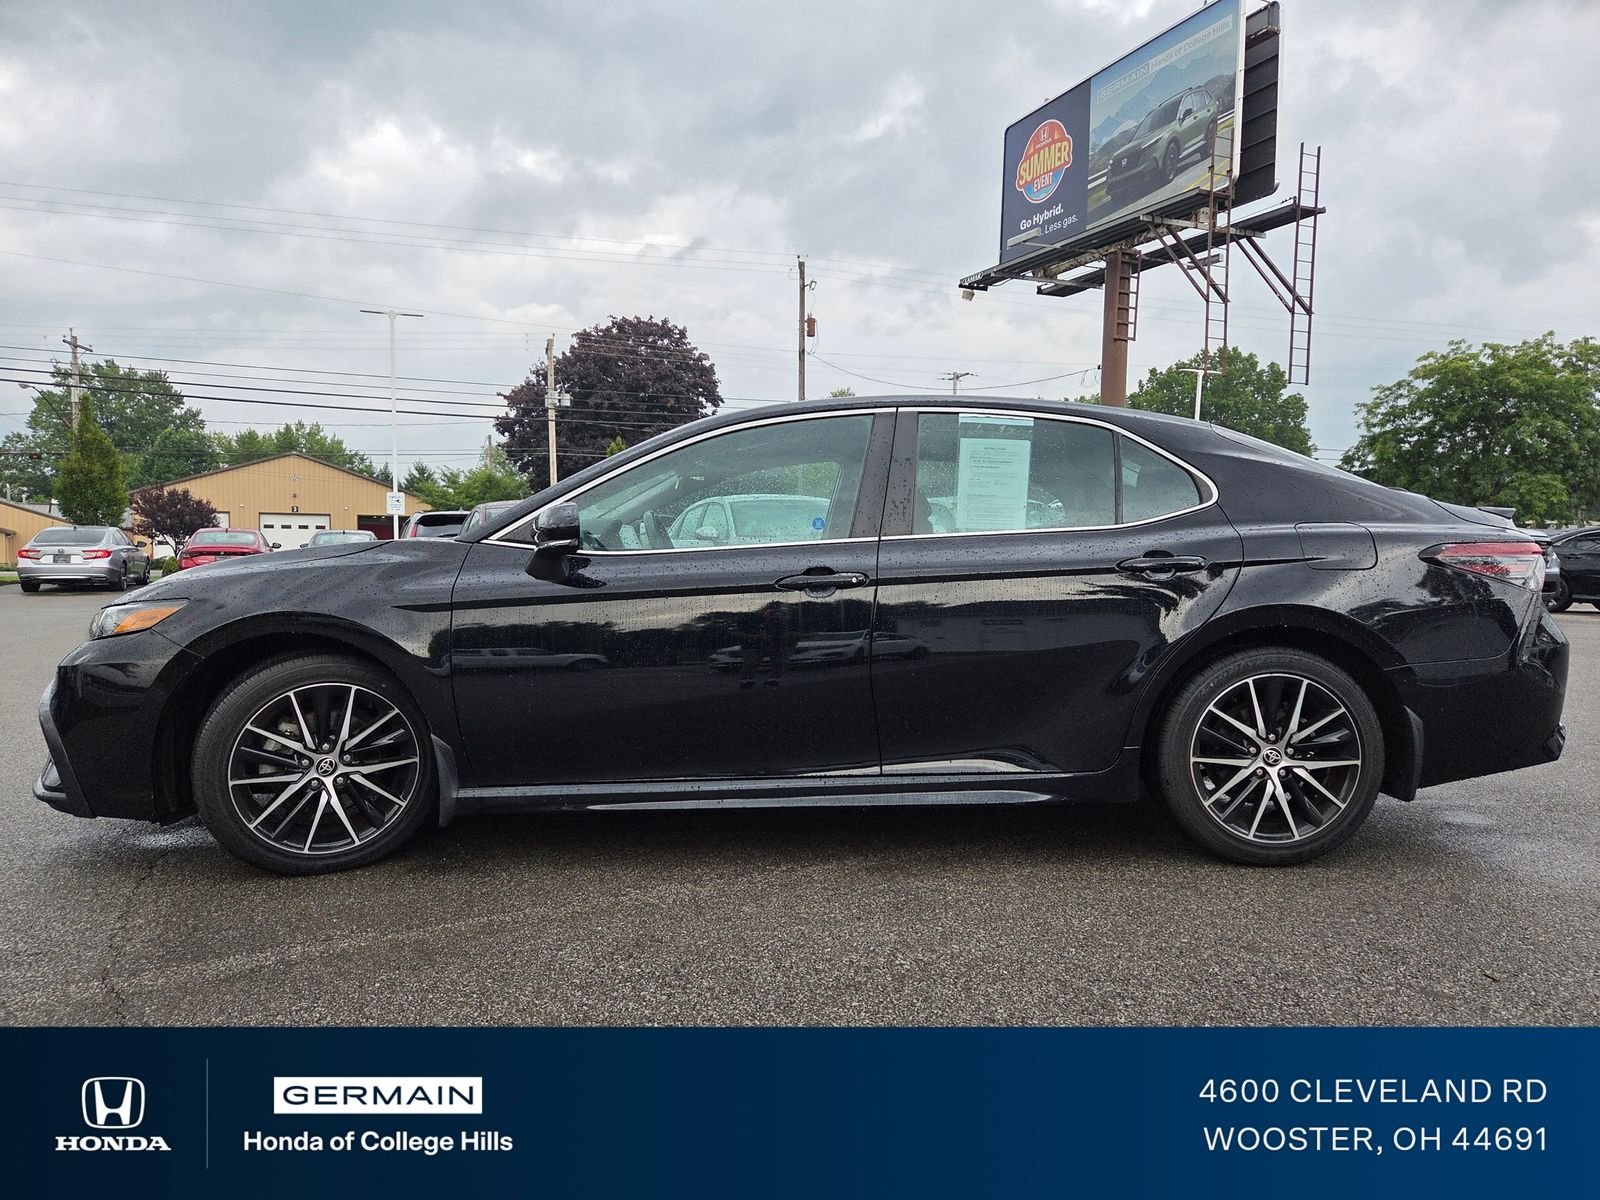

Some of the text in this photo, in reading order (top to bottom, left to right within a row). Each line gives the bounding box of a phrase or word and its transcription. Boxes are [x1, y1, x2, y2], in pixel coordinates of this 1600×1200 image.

[1100, 21, 1231, 98] GERMAIN Honda of College Hills
[1019, 141, 1070, 186] SUMMER
[1033, 172, 1053, 192] EVENT
[1020, 203, 1064, 230] Go Hybrid.
[1044, 214, 1079, 234] Less gas.
